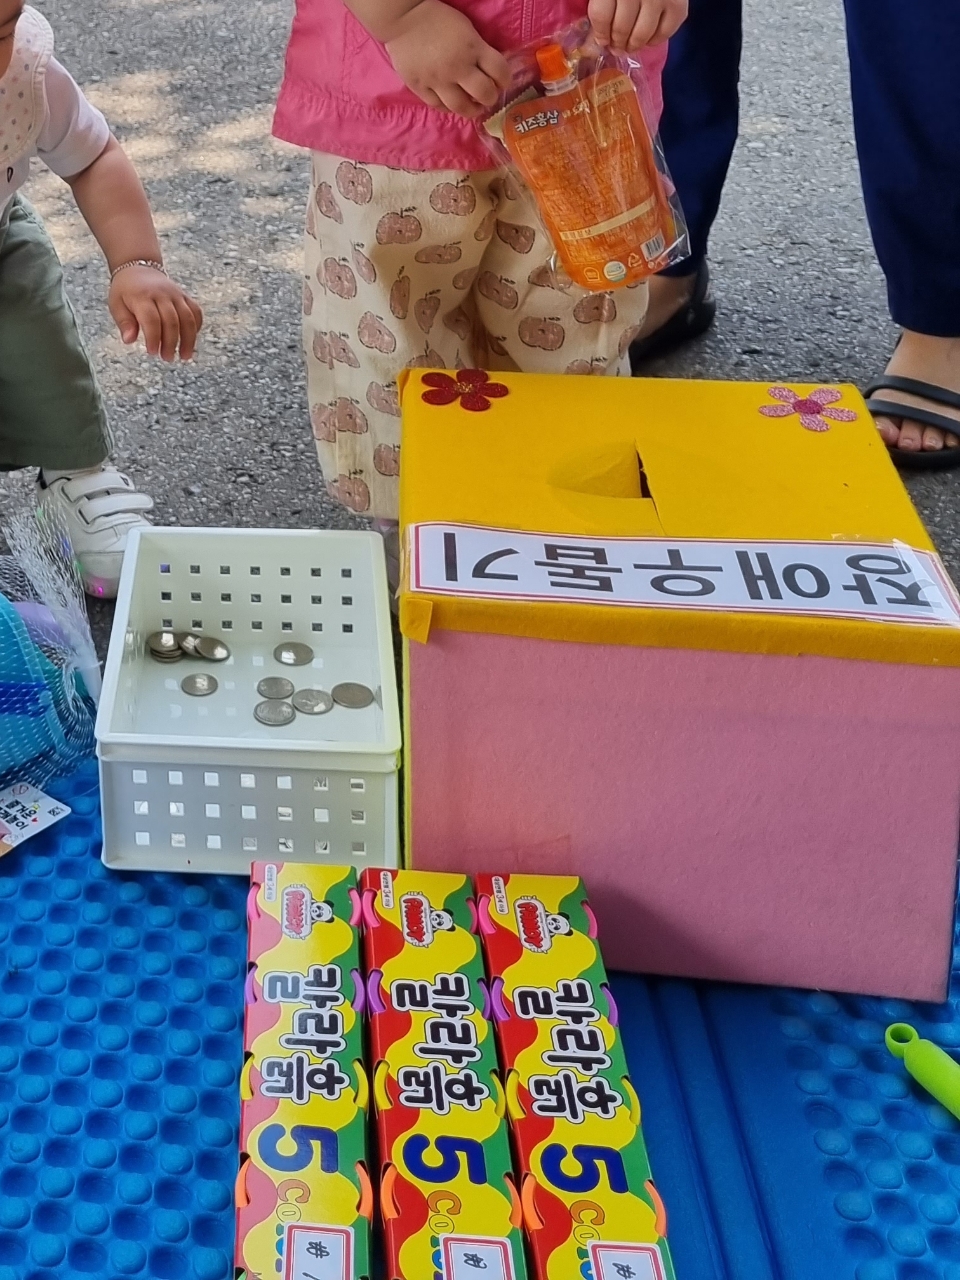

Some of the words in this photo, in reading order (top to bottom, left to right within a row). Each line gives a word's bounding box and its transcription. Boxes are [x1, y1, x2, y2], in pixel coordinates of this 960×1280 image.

[514, 109, 559, 134] 키즈홍삼
[442, 531, 938, 608] 장애우돕기
[516, 901, 544, 950] PANDY
[262, 966, 350, 1104] 칼라흙
[393, 974, 486, 1113] 칼라흙
[516, 980, 619, 1121] 칼라흙
[257, 1122, 339, 1174] 5
[402, 1132, 488, 1185] 5
[540, 1142, 630, 1194] 5
